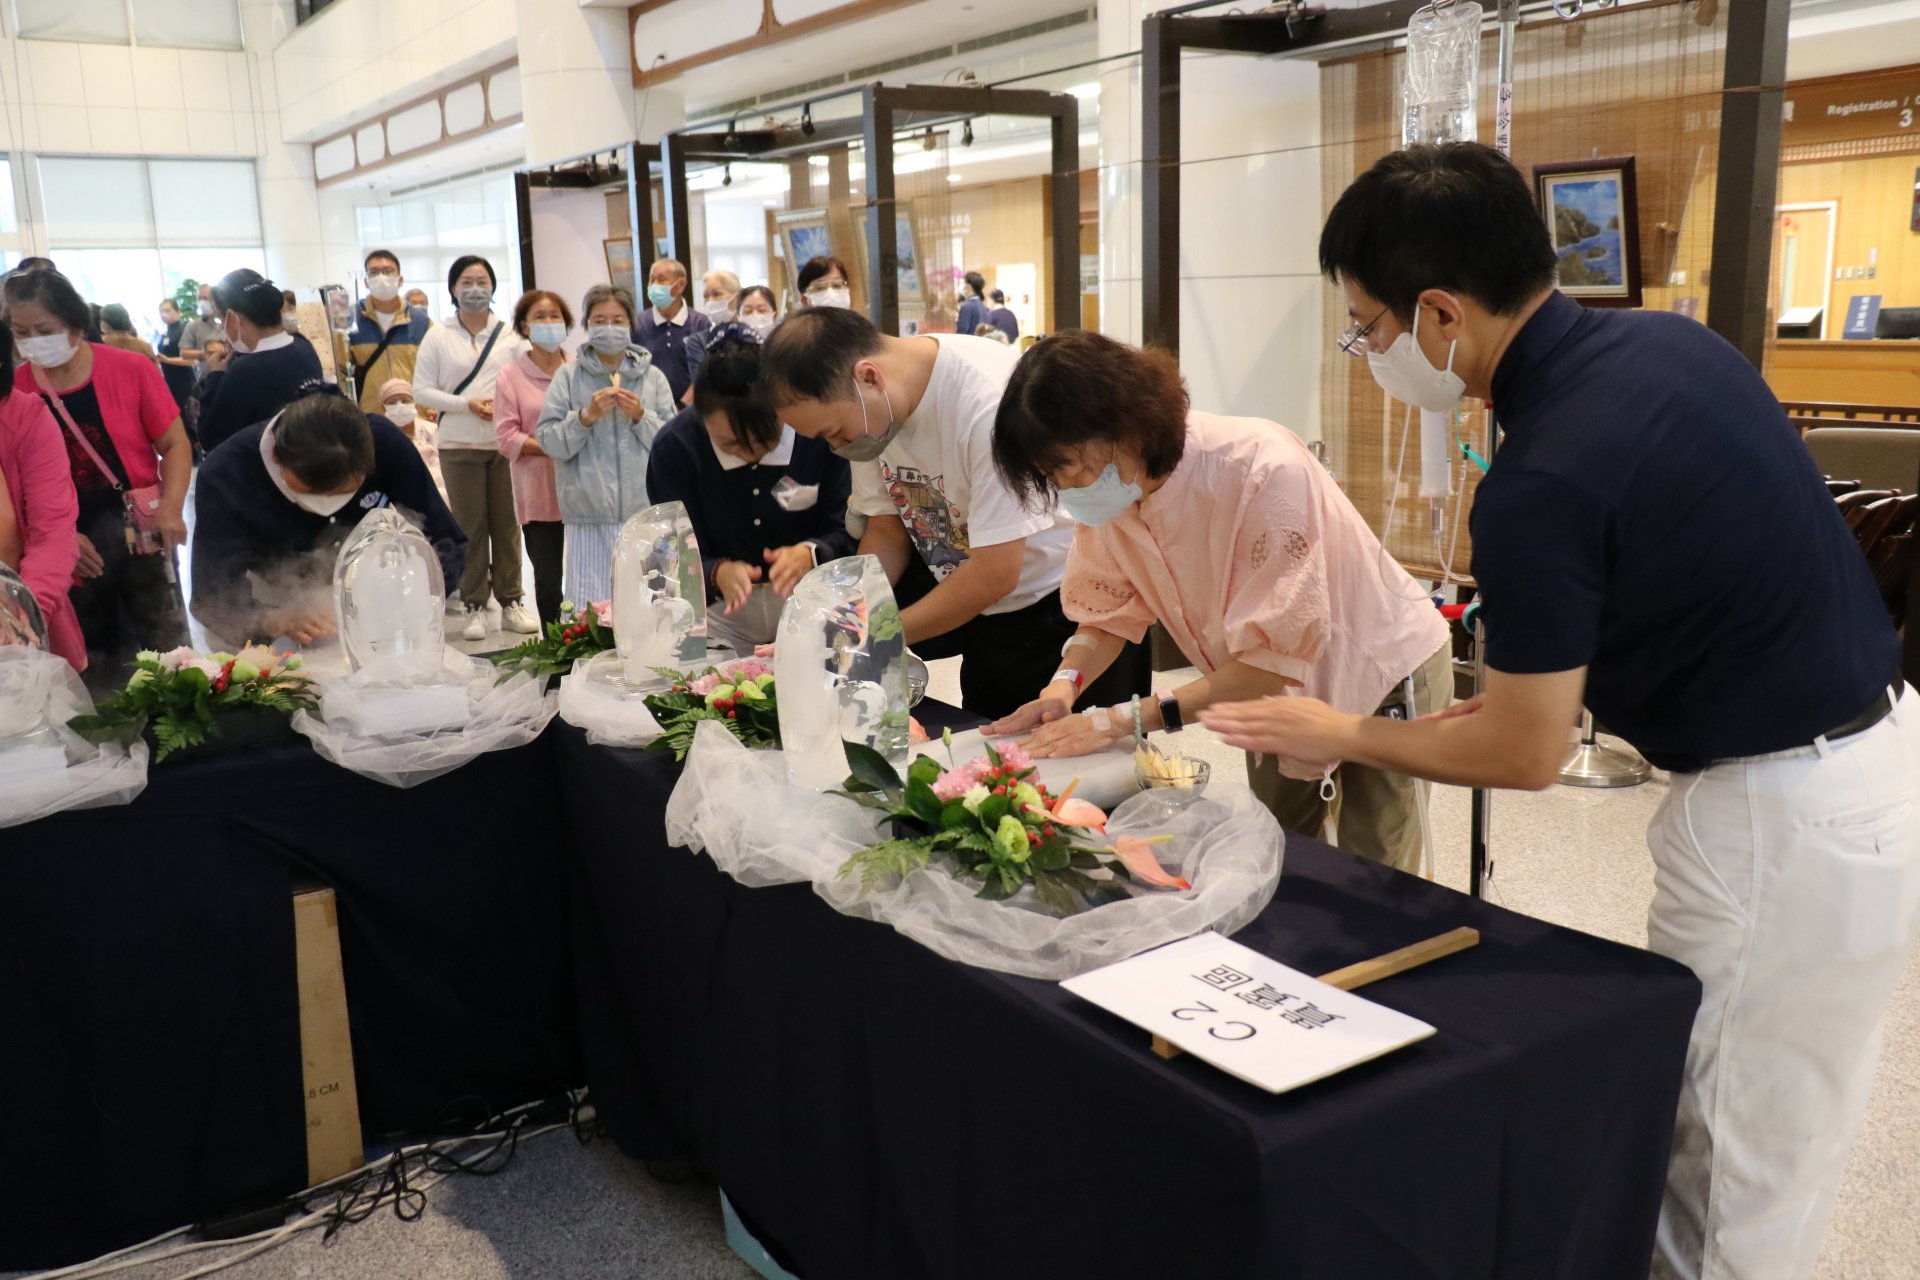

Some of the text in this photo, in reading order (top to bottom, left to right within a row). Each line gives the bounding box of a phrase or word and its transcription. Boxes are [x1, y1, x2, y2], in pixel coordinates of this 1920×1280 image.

[1827, 99, 1898, 116] Registration
[1899, 108, 1913, 128] 3
[1191, 964, 1346, 1030] 貴賓區
[319, 1081, 340, 1096] CM
